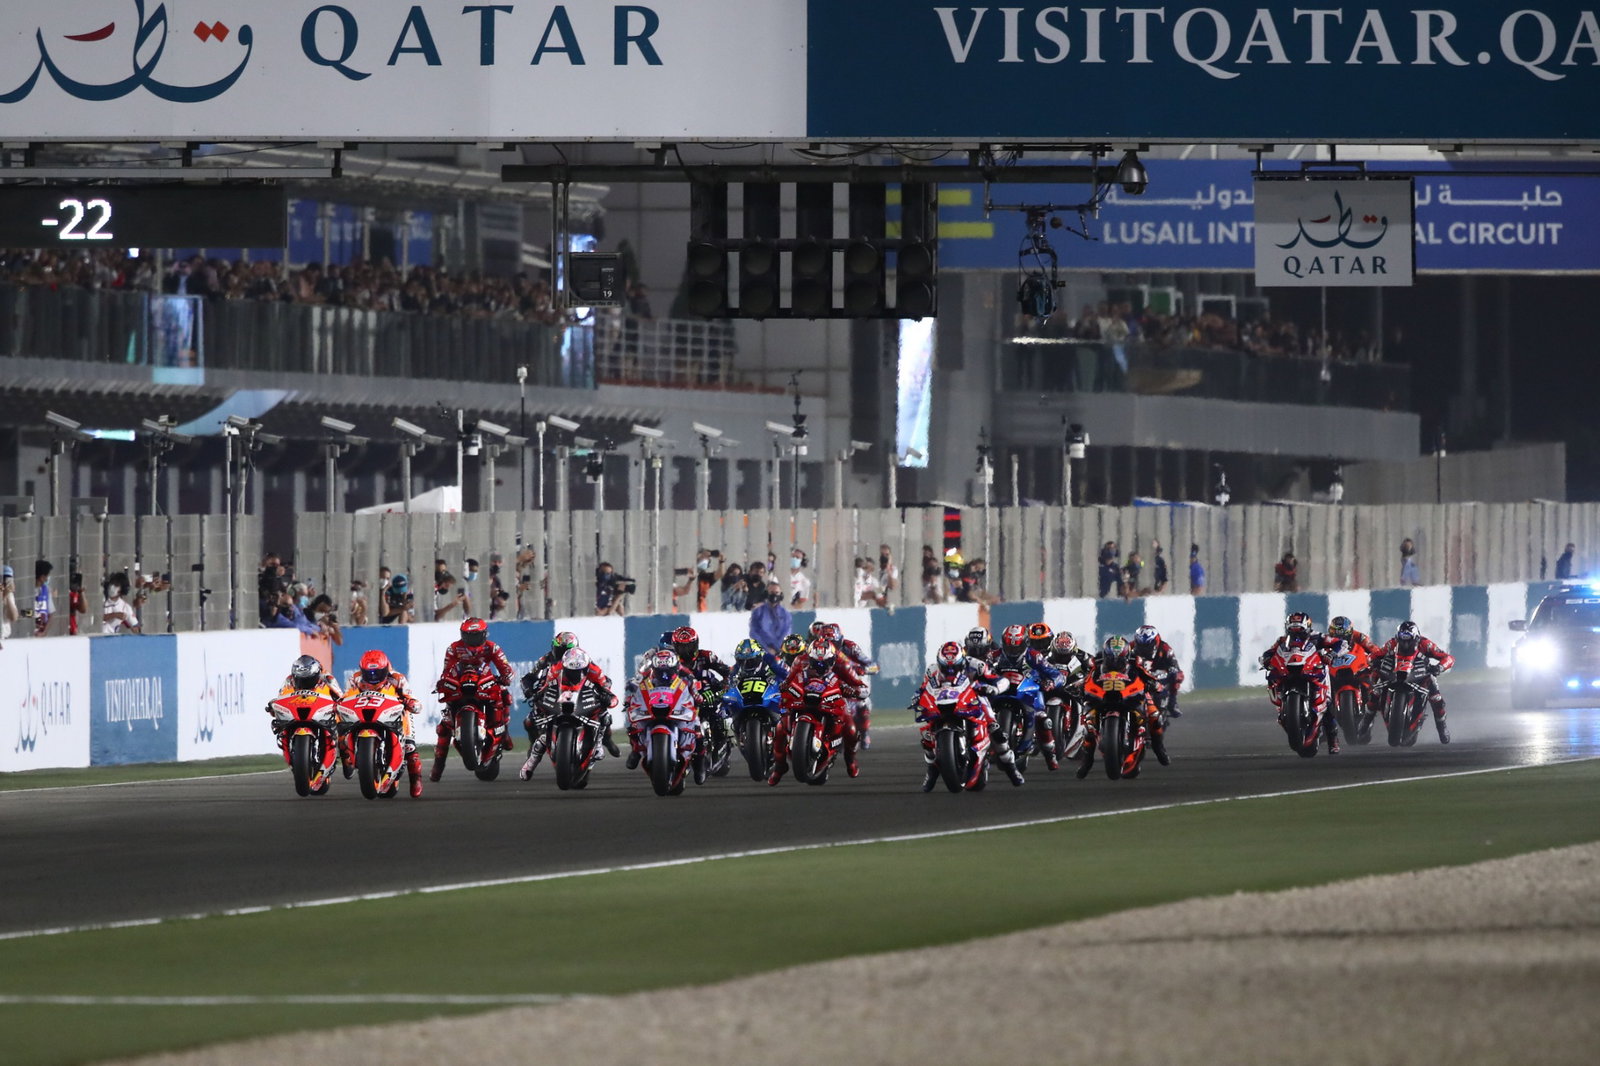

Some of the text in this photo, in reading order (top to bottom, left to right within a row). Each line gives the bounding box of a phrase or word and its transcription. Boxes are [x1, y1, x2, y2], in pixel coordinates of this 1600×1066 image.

[301, 4, 664, 81] QATAR
[933, 7, 1600, 81] VISITQATAR.QA
[42, 198, 113, 240] -22
[1103, 221, 1202, 245] LUSAIL
[1448, 221, 1563, 245] CIRCUIT
[1284, 255, 1387, 279] QATAR
[603, 290, 613, 298] 19
[649, 691, 675, 705] 23
[740, 680, 767, 694] 36
[354, 696, 386, 709] 93
